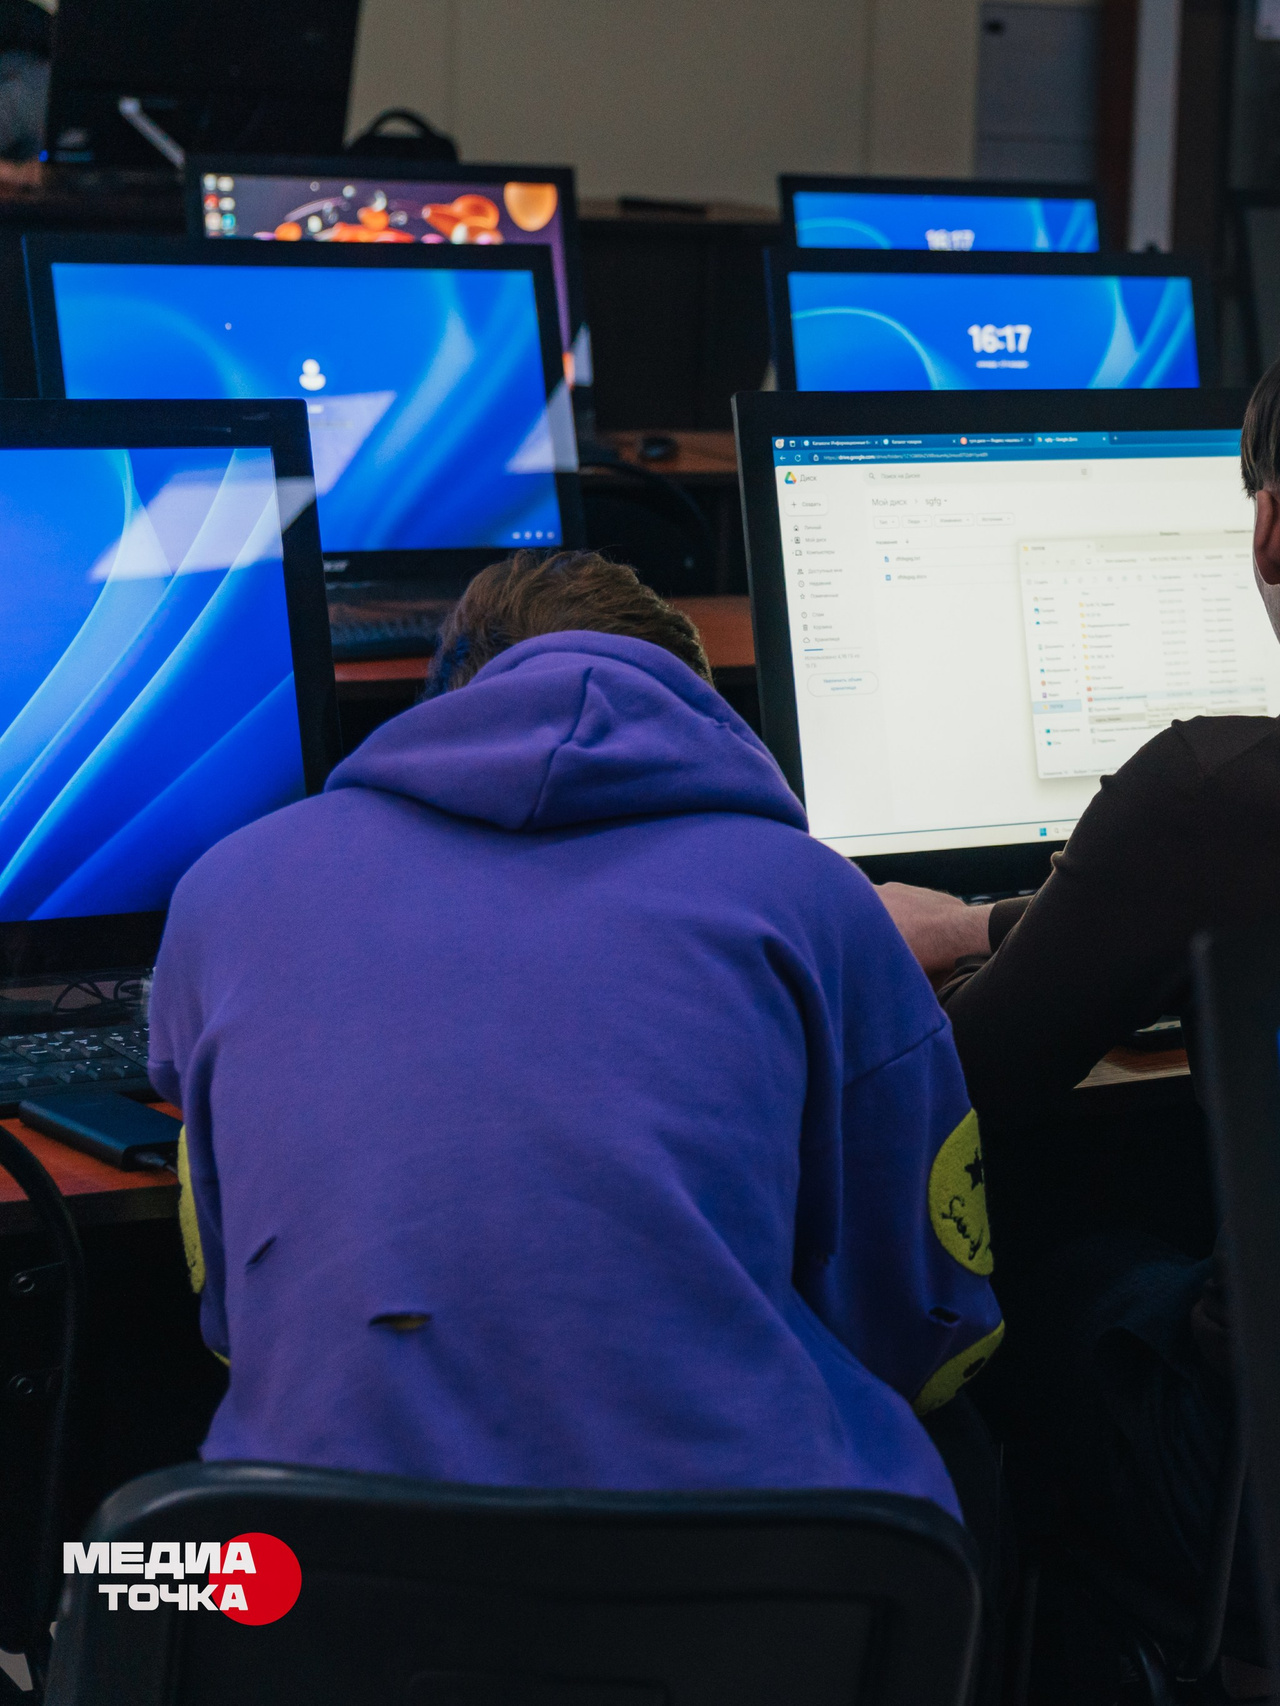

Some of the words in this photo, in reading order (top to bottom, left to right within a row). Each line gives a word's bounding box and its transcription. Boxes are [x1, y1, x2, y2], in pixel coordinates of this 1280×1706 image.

[967, 324, 1032, 353] 16:17
[800, 474, 817, 482] Диск
[872, 498, 888, 506] Мой
[889, 498, 907, 507] диск
